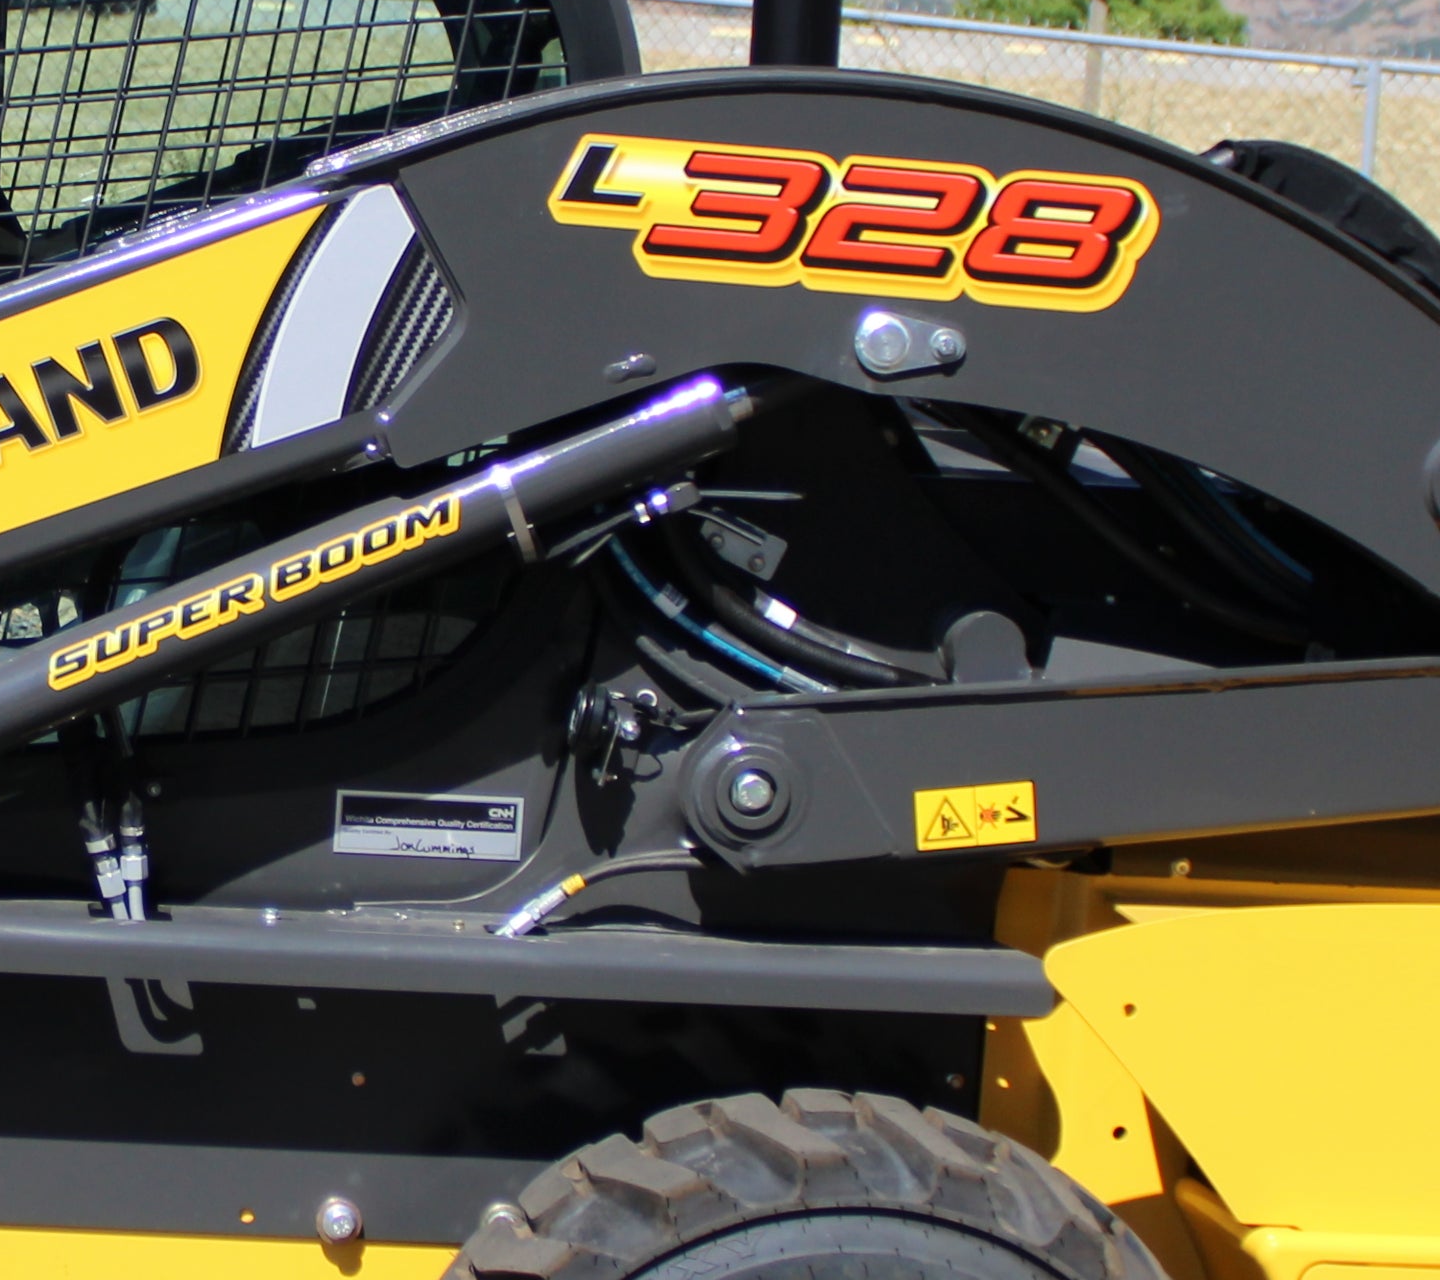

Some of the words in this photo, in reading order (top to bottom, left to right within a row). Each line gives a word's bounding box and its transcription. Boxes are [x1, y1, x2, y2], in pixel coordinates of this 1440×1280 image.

[554, 137, 1154, 300] L328
[50, 575, 263, 687] SUPER
[270, 495, 460, 600] BOOM
[375, 816, 436, 828] Comprehensive
[437, 819, 465, 830] Quality
[466, 820, 514, 831] Certification
